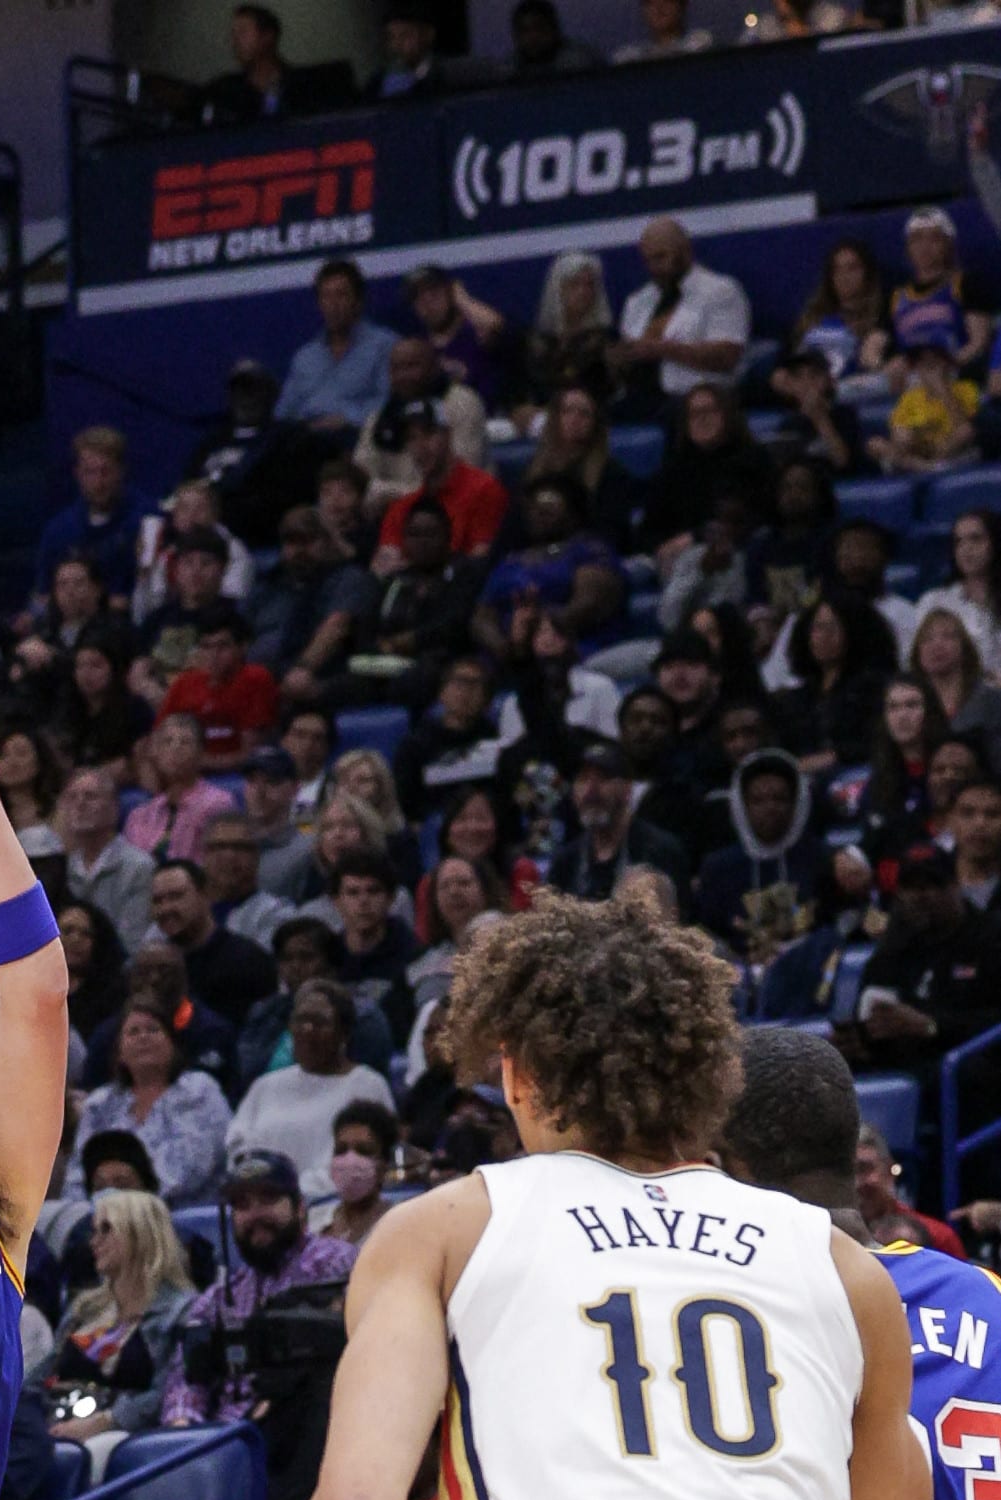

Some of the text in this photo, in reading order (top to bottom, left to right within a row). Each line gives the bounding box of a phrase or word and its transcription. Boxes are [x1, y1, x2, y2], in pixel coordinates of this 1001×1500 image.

[152, 139, 375, 240] ESPN
[498, 117, 761, 206] 100.3 FM
[148, 212, 375, 271] NEW ORLEANS
[566, 1206, 765, 1266] HAYES
[578, 1287, 784, 1461] 10
